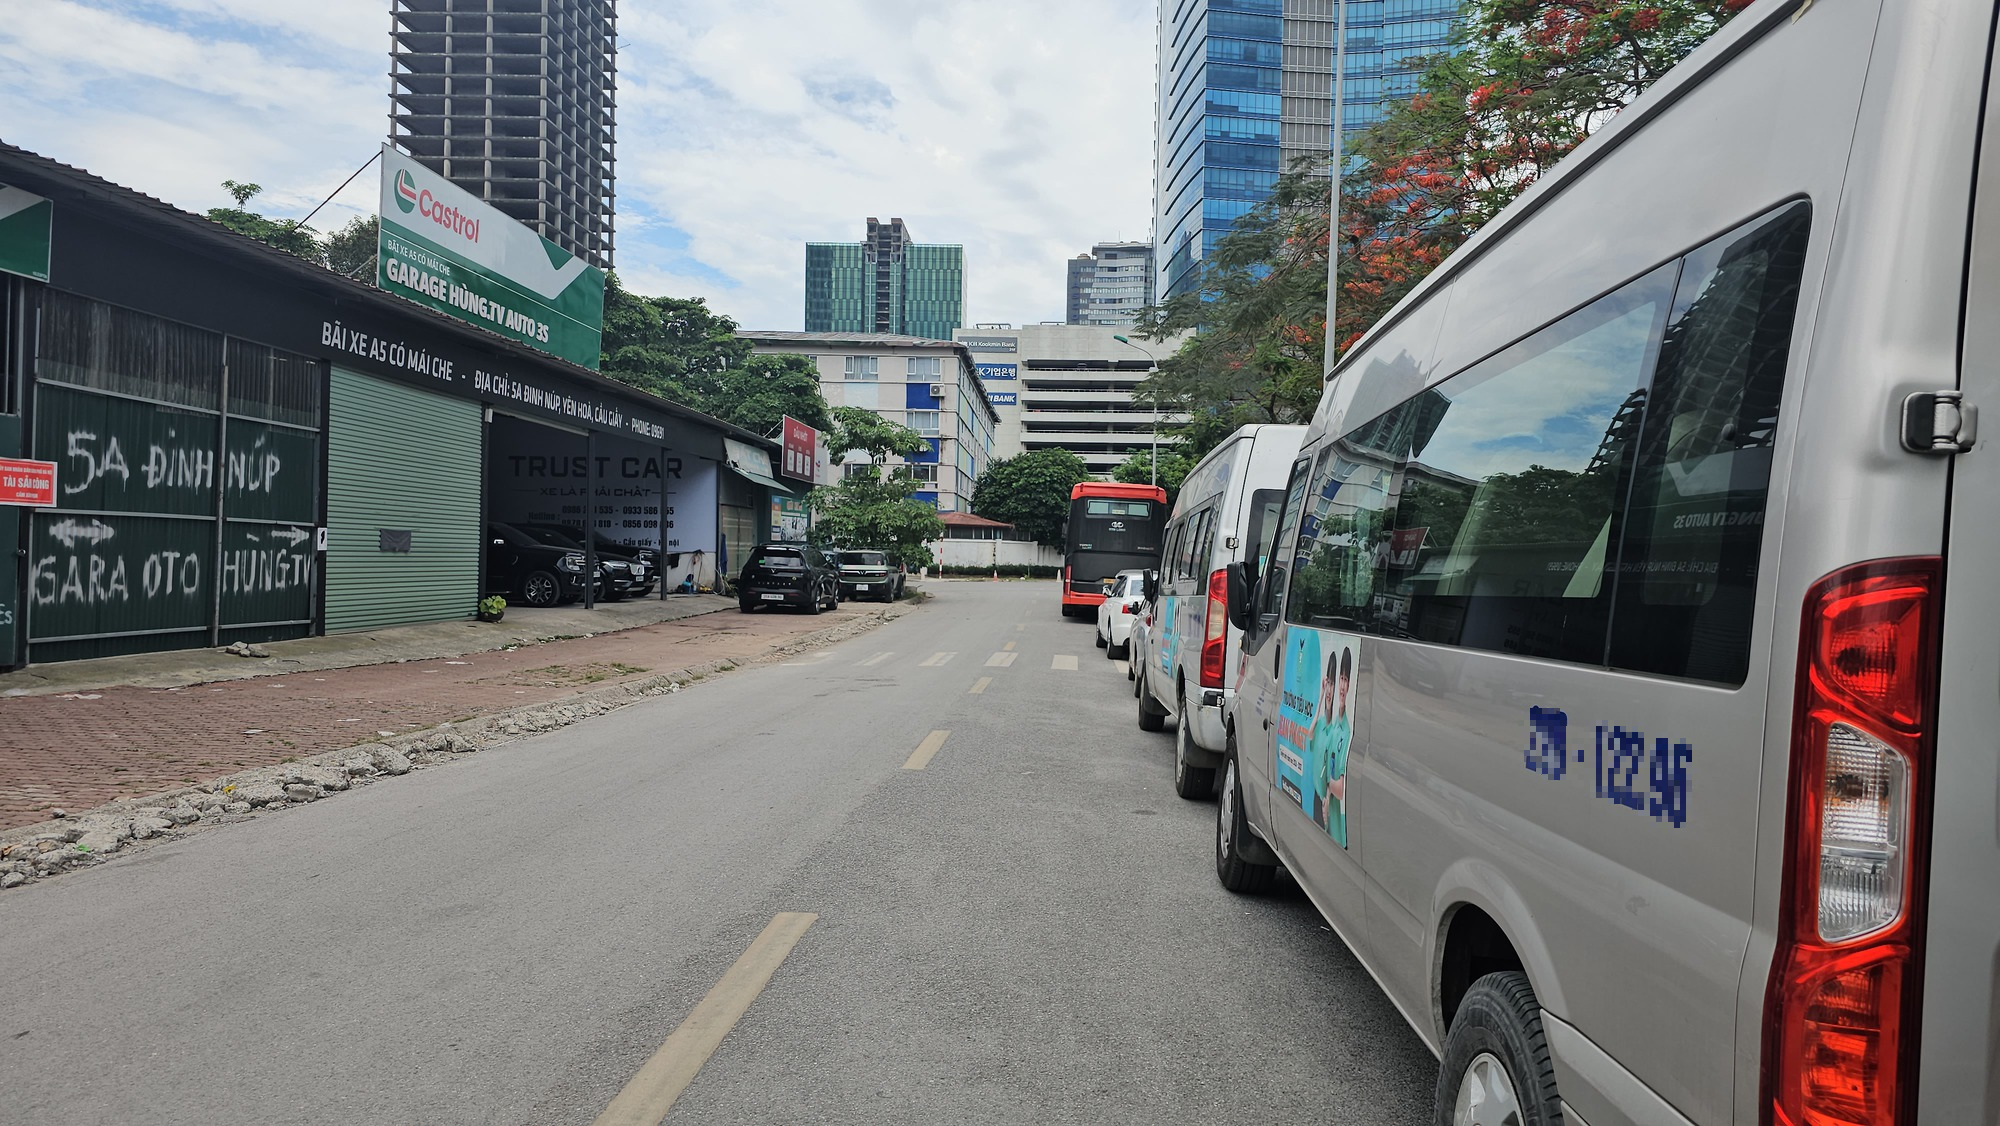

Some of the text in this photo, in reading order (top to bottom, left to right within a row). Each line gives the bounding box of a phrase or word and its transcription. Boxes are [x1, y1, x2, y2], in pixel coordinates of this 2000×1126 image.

[419, 189, 480, 243] Castrol
[387, 239, 450, 276] BÃI XE A5 CÓ MÁI CHE
[386, 257, 549, 344] GARAGE HÙNG.TV AUTO 3S
[321, 320, 347, 351] BÃI
[349, 330, 368, 357] XE
[369, 337, 387, 362] A5
[389, 341, 405, 367] CÓ
[407, 348, 431, 375] MÁI
[432, 357, 453, 381] CHE
[474, 369, 491, 394] ĐỊA
[511, 383, 522, 401] 5A
[523, 386, 543, 407] ĐINH
[562, 395, 577, 416] YÊN
[3, 475, 16, 488] TÀI
[64, 429, 130, 495] 5A
[228, 434, 281, 498] NÚP
[508, 455, 683, 480] TRUST CAR
[540, 487, 557, 496] XE
[560, 486, 576, 497] LÀ
[622, 506, 642, 515] 0933
[31, 553, 130, 606] GARA
